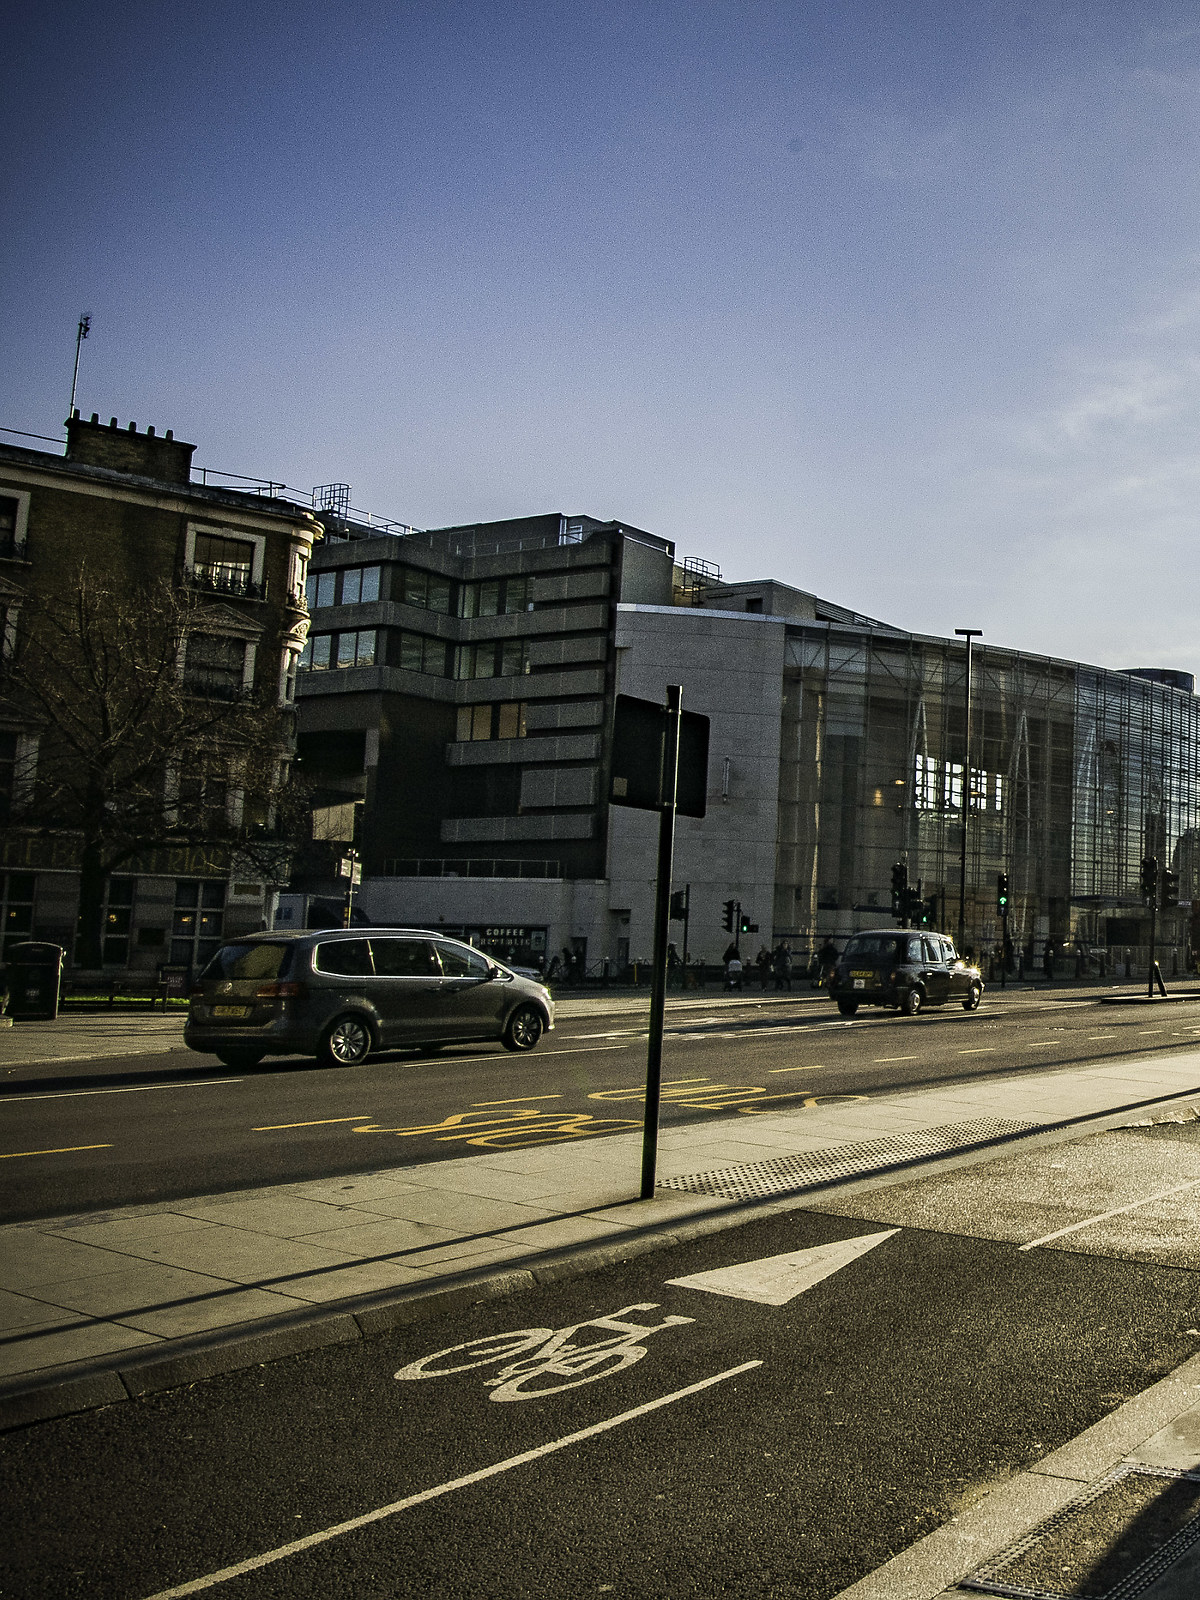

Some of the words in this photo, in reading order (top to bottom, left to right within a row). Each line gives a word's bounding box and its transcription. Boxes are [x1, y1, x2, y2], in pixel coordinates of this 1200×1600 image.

[486, 928, 525, 937] COFFEE
[588, 1078, 870, 1114] STOP
[352, 1109, 645, 1148] BUS
